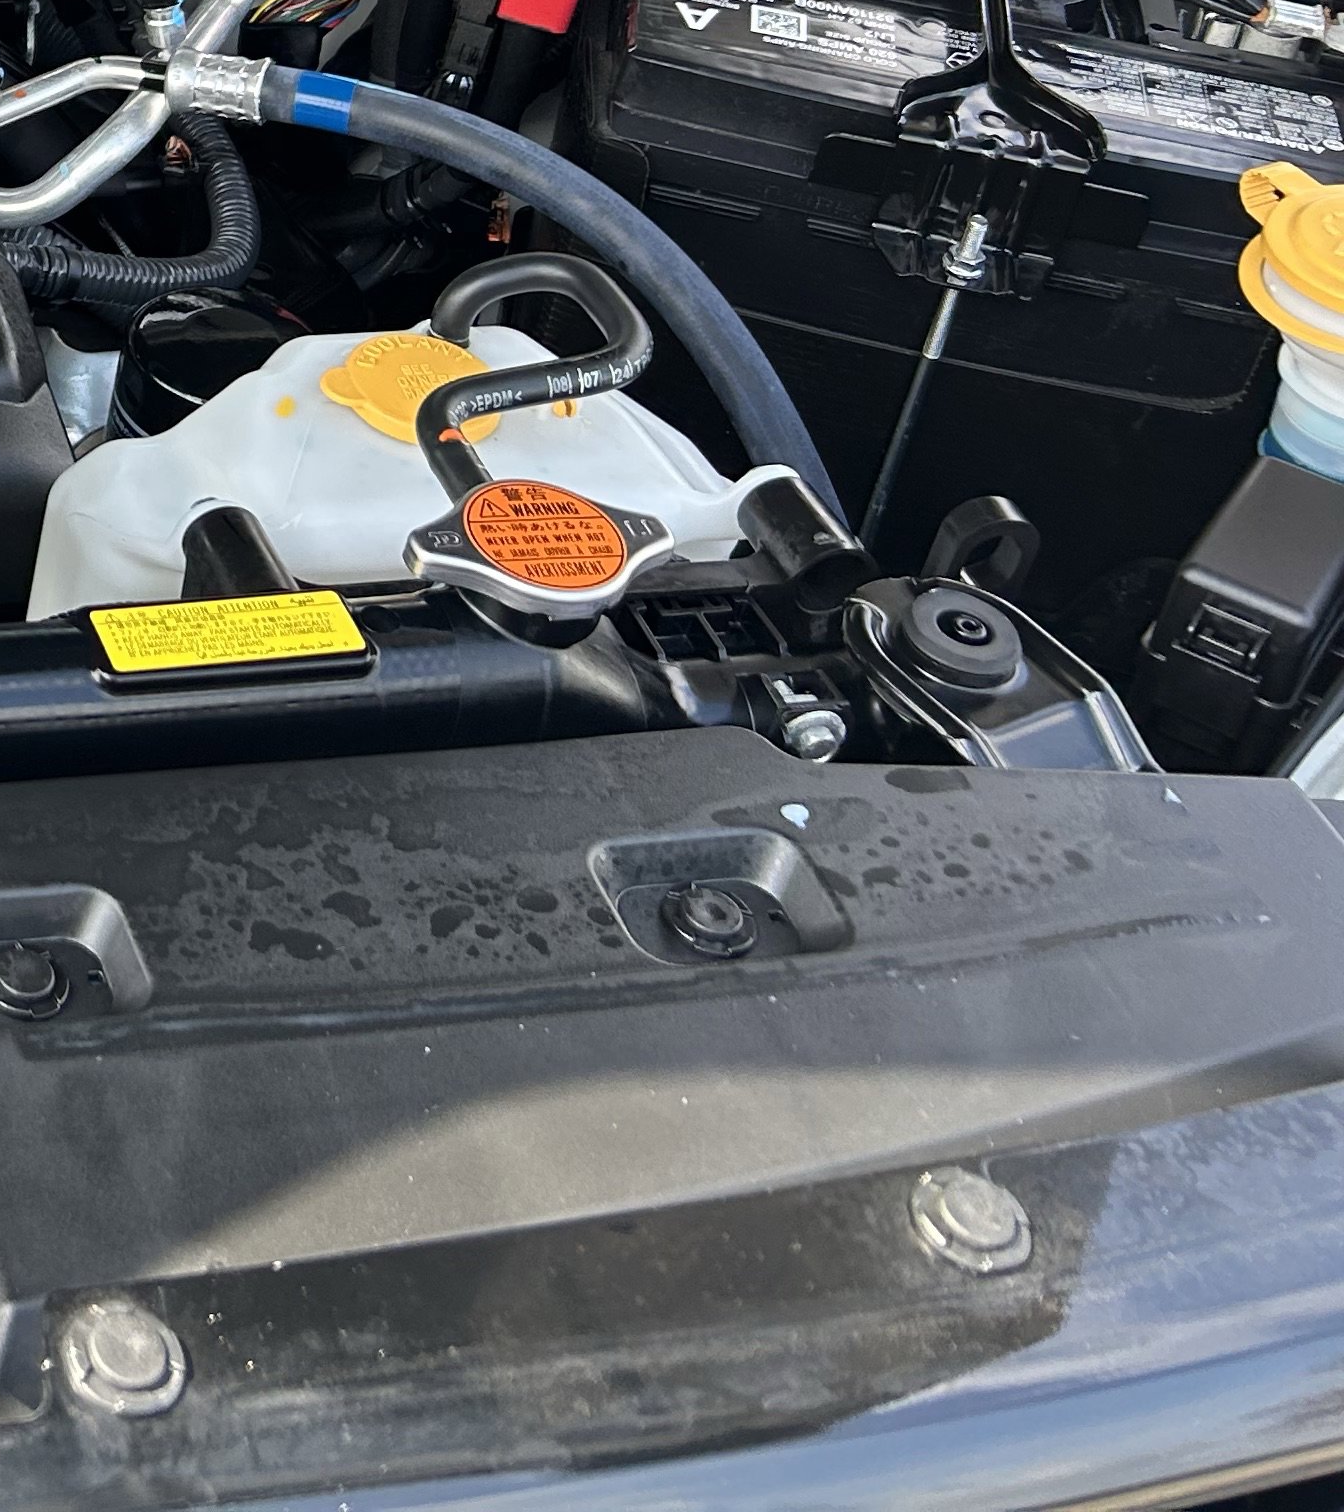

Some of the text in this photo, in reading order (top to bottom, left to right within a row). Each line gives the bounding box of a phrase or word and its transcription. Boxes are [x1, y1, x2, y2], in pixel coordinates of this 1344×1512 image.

[817, 38, 866, 55] AMPS
[356, 334, 473, 368] COOLANT
[501, 487, 548, 502] 警告
[508, 501, 581, 518] WARNING
[484, 535, 520, 546] NEVER
[522, 534, 550, 545] OPEN
[552, 533, 582, 544] WHEN
[511, 547, 540, 558] JAMAIS
[524, 560, 608, 578] AVERTISSMENT
[157, 606, 210, 619] CAUTION
[216, 600, 279, 614] ATTENTION
